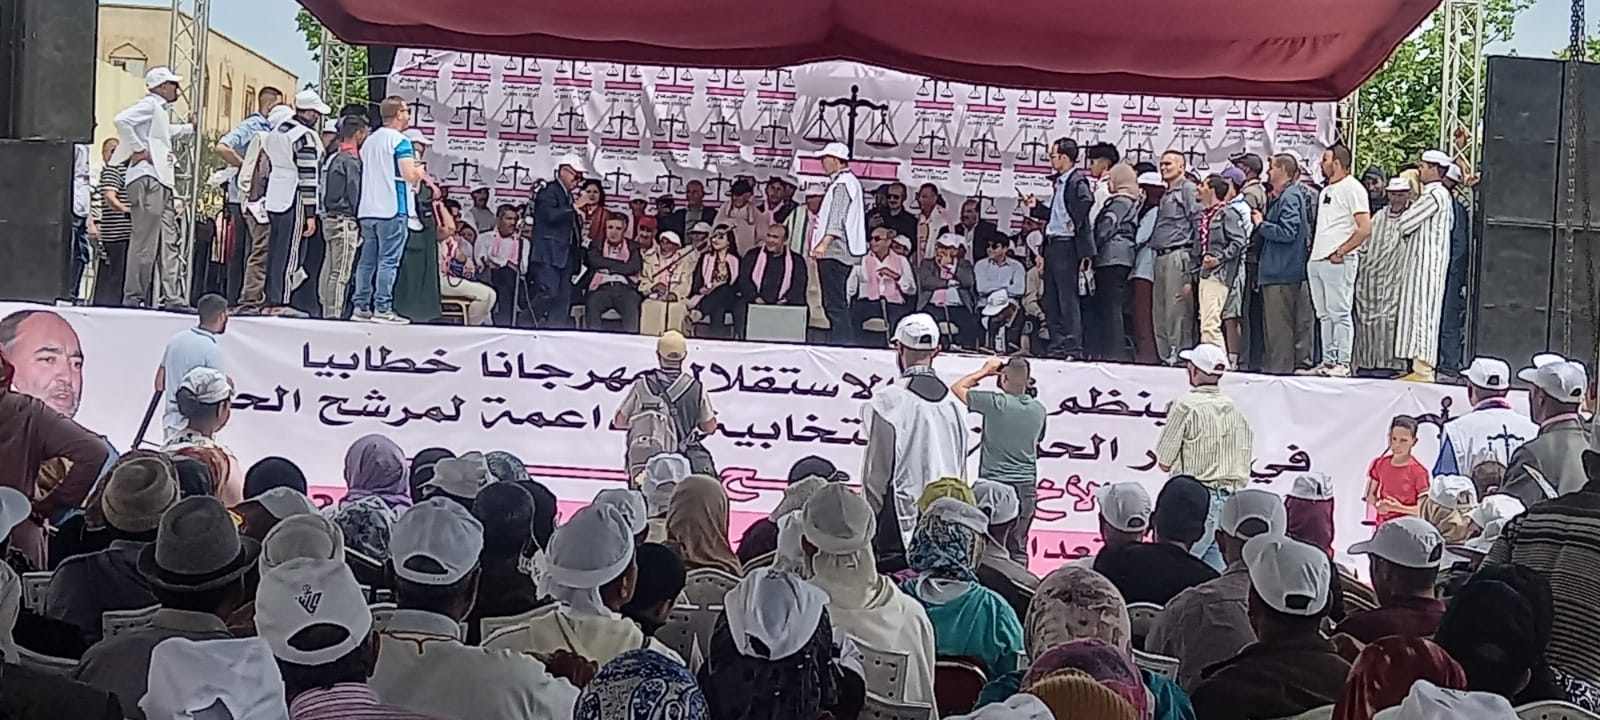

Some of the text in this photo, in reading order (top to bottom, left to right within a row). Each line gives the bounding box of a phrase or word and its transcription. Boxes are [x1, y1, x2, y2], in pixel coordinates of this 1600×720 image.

[303, 341, 461, 379] خطابيا
[229, 384, 302, 413] الح
[317, 389, 466, 428] لمرشح
[1249, 443, 1311, 485] في
